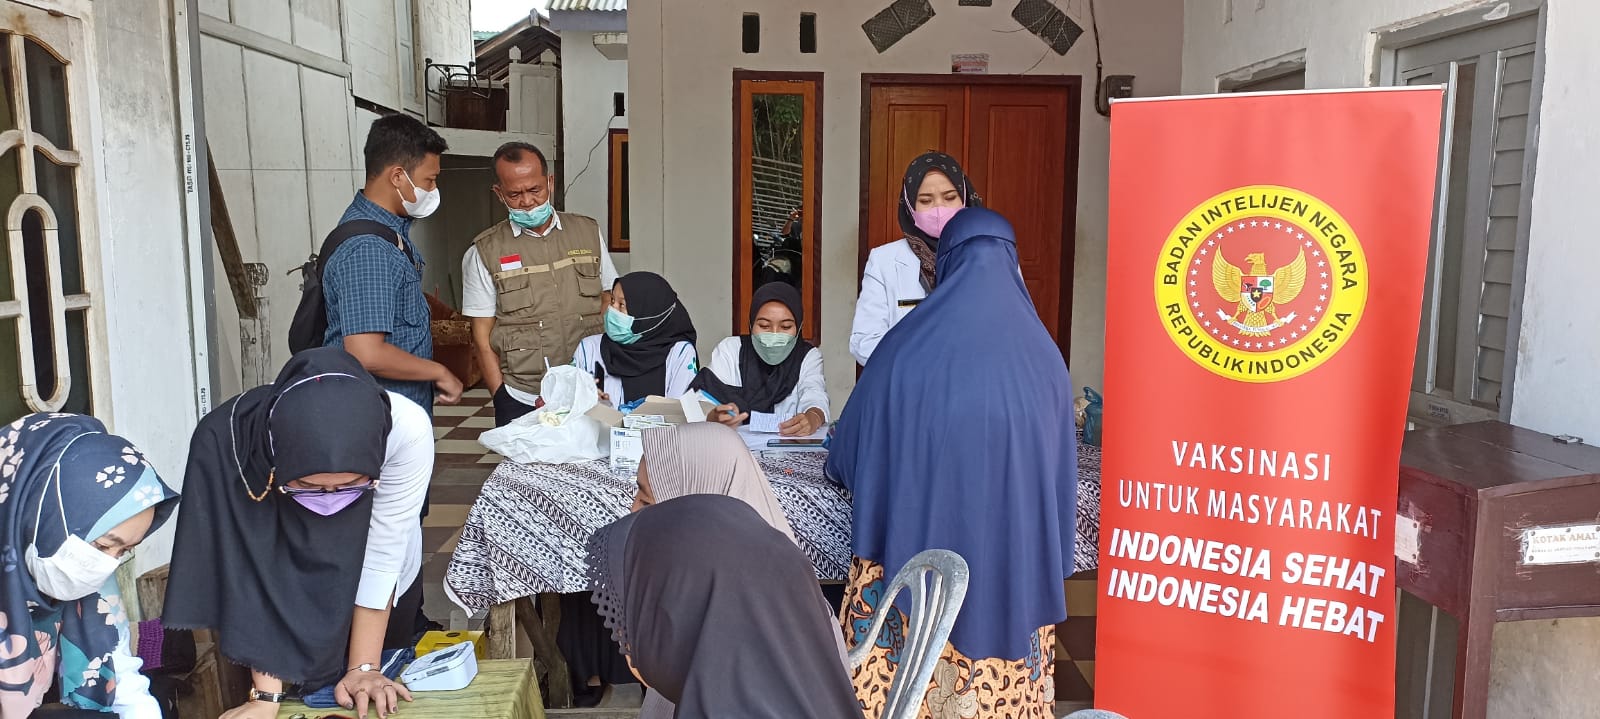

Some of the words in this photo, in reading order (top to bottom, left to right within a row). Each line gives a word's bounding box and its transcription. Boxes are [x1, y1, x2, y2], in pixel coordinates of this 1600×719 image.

[1164, 222, 1202, 285] BADAN
[1201, 194, 1308, 225] INTELIJEN
[1309, 211, 1357, 290] NEGARA
[1166, 303, 1244, 374] REPUBLIK
[1248, 314, 1352, 375] INDONESIA
[1171, 440, 1331, 482] VAKSINASI
[1119, 479, 1200, 515] UNTUK
[1207, 488, 1382, 540] MASYARAKAT
[1532, 534, 1566, 544] KOTAK
[1569, 532, 1598, 542] AMAL
[1109, 527, 1271, 581] INDONESIA
[1281, 551, 1386, 598] SEHAT
[1107, 568, 1269, 624] INDONESIA
[1278, 595, 1385, 643] HEBAT
